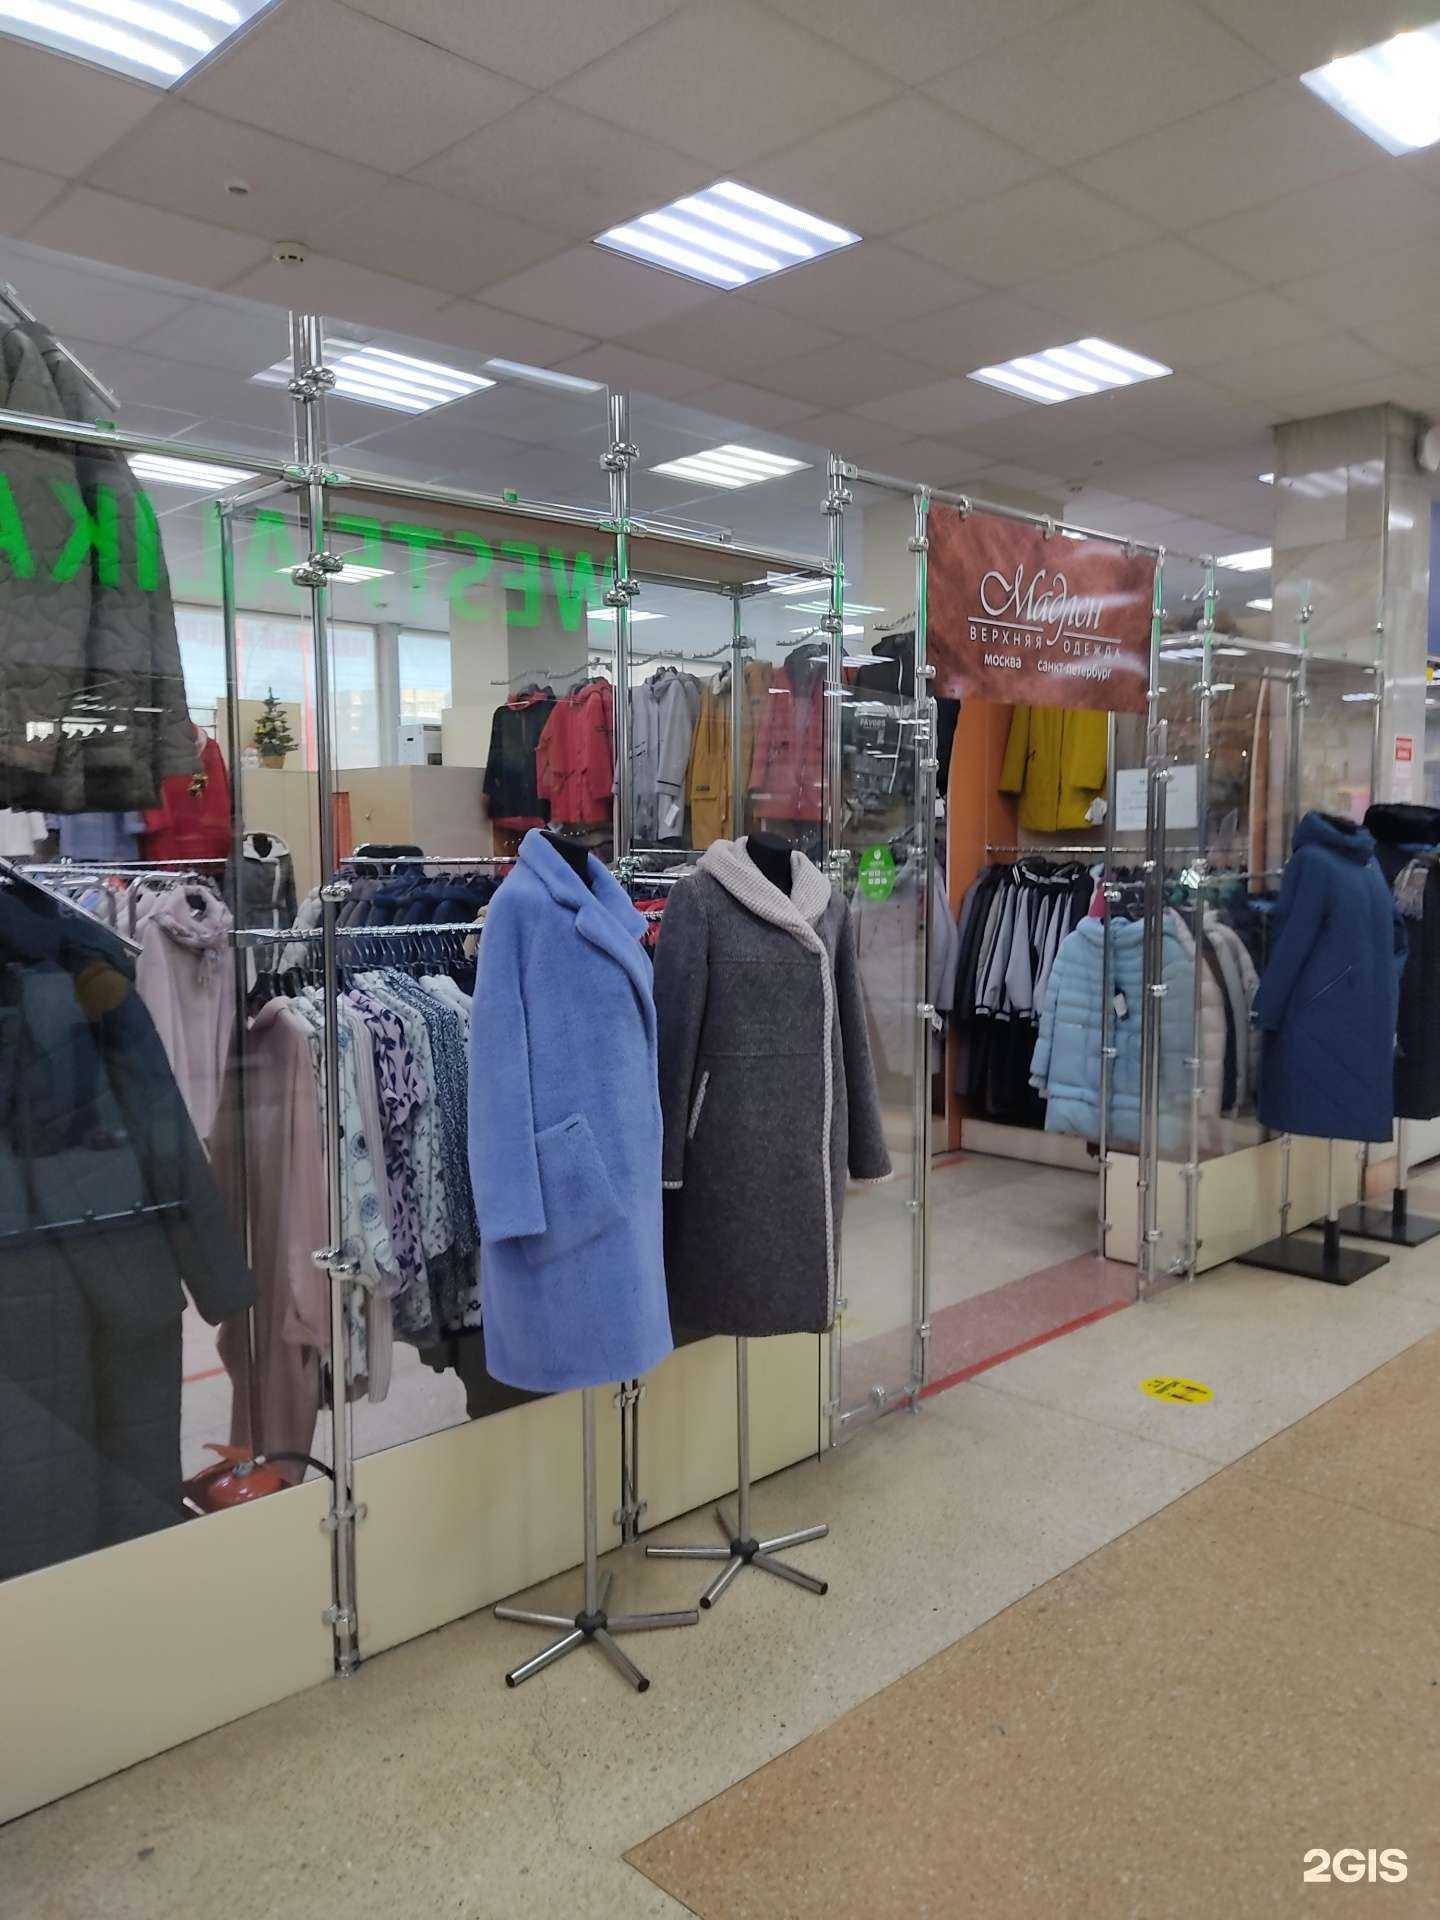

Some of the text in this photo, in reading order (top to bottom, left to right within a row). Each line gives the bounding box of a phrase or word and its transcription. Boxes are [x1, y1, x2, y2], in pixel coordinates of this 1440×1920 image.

[980, 563, 1103, 645] Мадлен
[970, 625, 1121, 659] ВЕРХНЯЯ ОДЕЖДА
